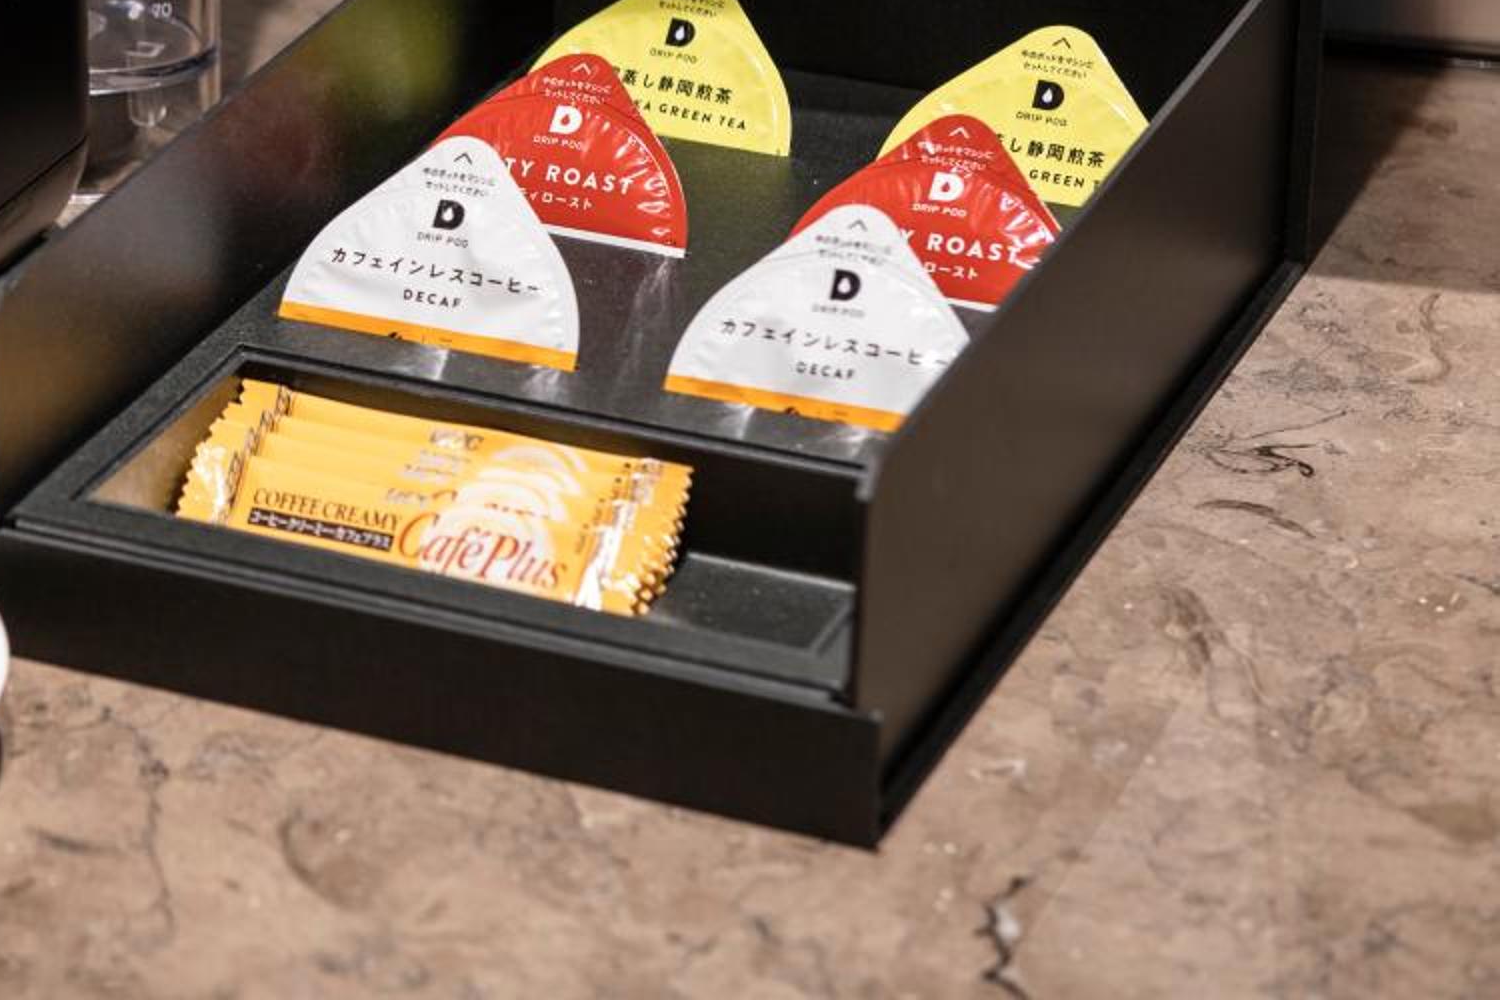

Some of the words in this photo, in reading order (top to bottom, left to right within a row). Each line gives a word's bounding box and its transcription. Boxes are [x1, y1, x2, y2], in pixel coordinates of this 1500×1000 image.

[659, 103, 712, 123] GREEN
[719, 116, 746, 130] TEA
[545, 164, 633, 195] ROAST
[1029, 169, 1085, 188] GREEN
[417, 232, 442, 242] DRIP
[927, 232, 1021, 263] ROAST
[332, 248, 539, 294] カフェインレスコーヒー
[403, 289, 461, 308] DECAF
[720, 320, 949, 366] カフェインレスコーヒー
[796, 362, 855, 380] DECAF
[253, 487, 319, 515] COFFEE
[322, 501, 399, 531] CREAMY
[481, 535, 567, 588] Plus
